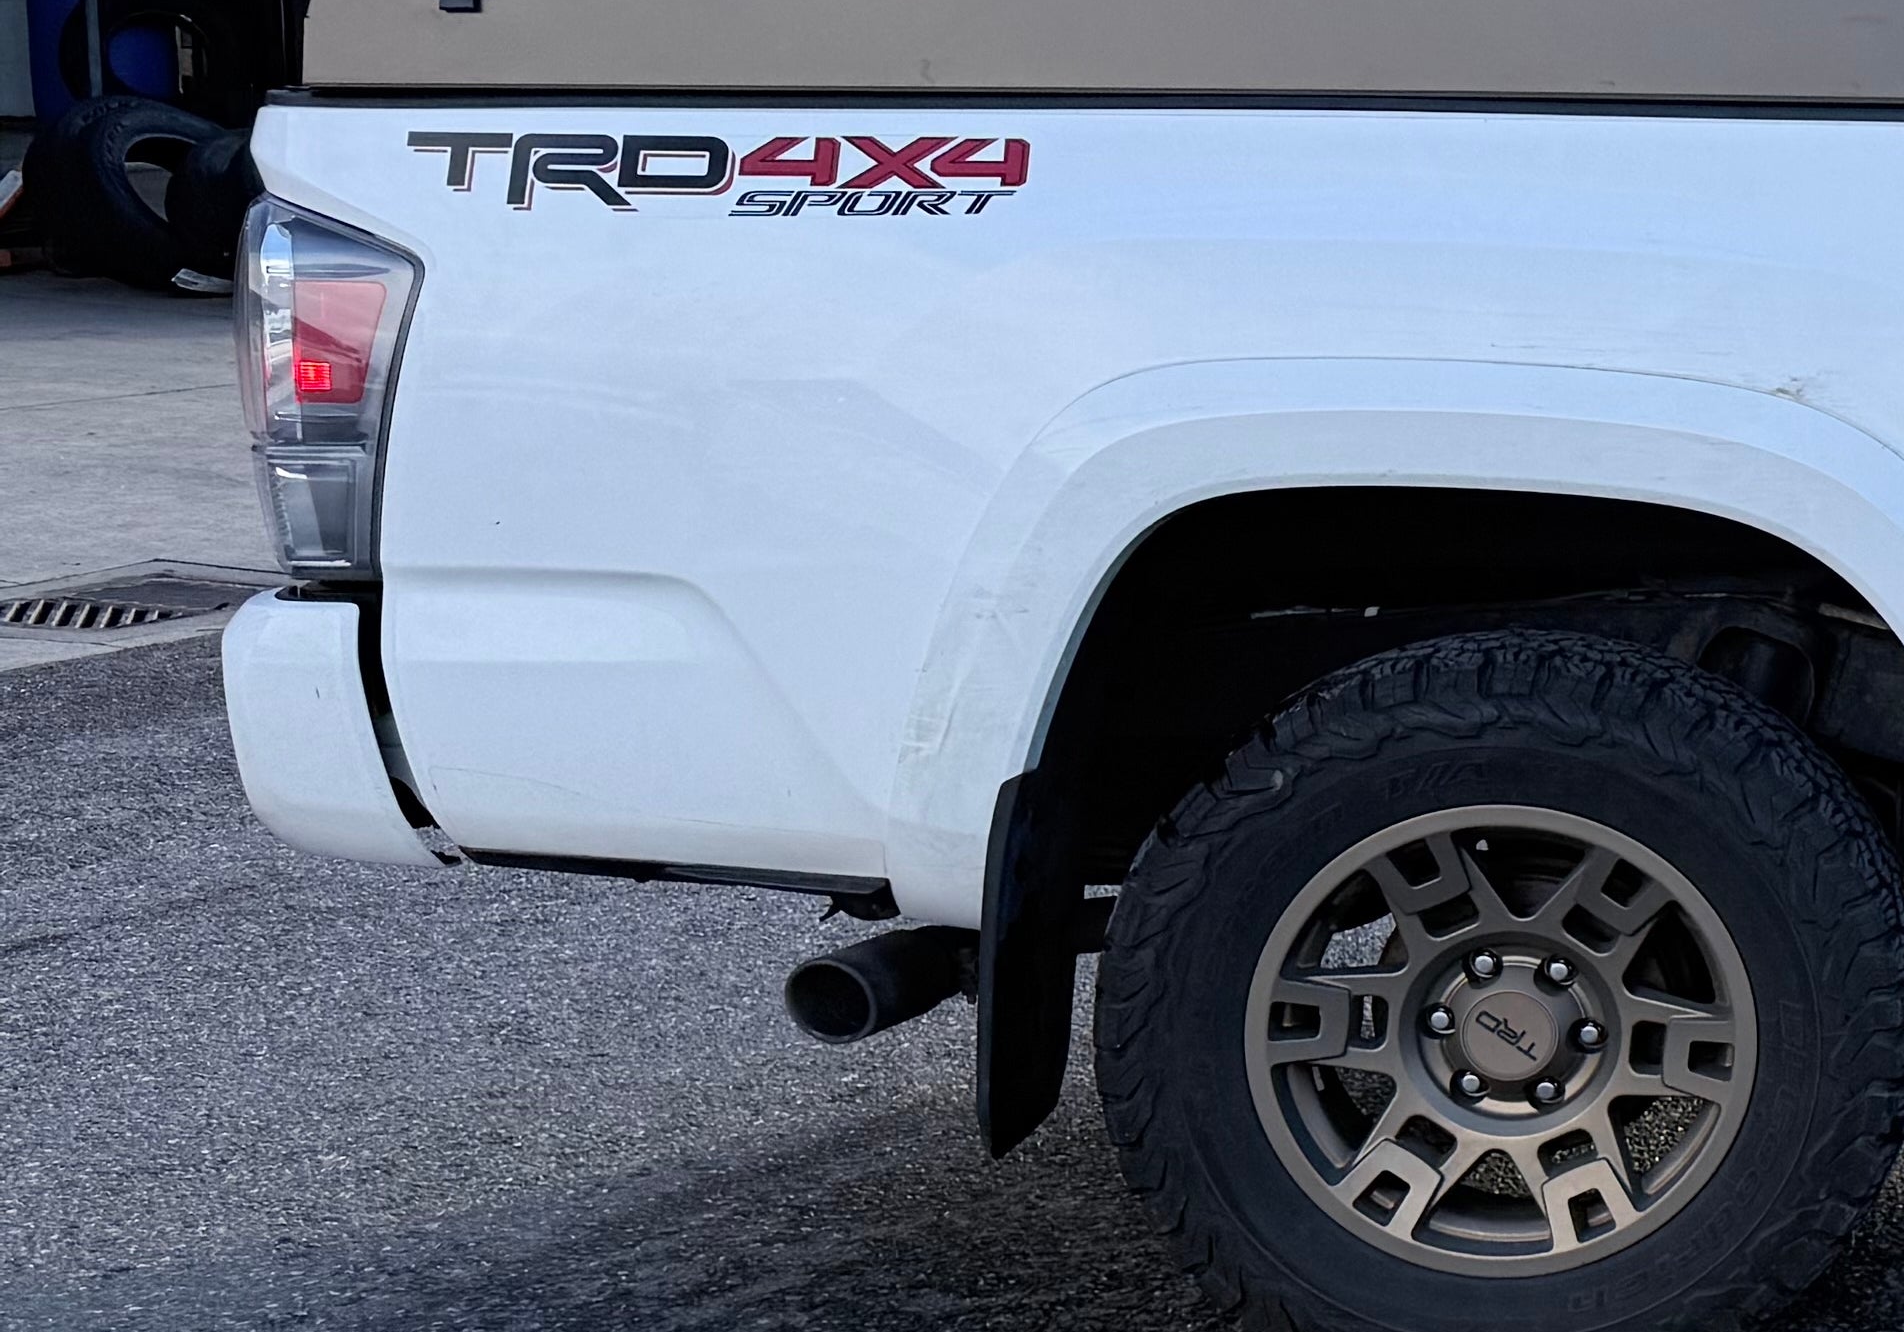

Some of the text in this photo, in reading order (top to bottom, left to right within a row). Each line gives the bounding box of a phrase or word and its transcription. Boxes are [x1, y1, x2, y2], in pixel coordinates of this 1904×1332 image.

[407, 130, 736, 211] TRD
[728, 190, 1017, 218] SPORT
[1476, 1010, 1537, 1061] TRD
